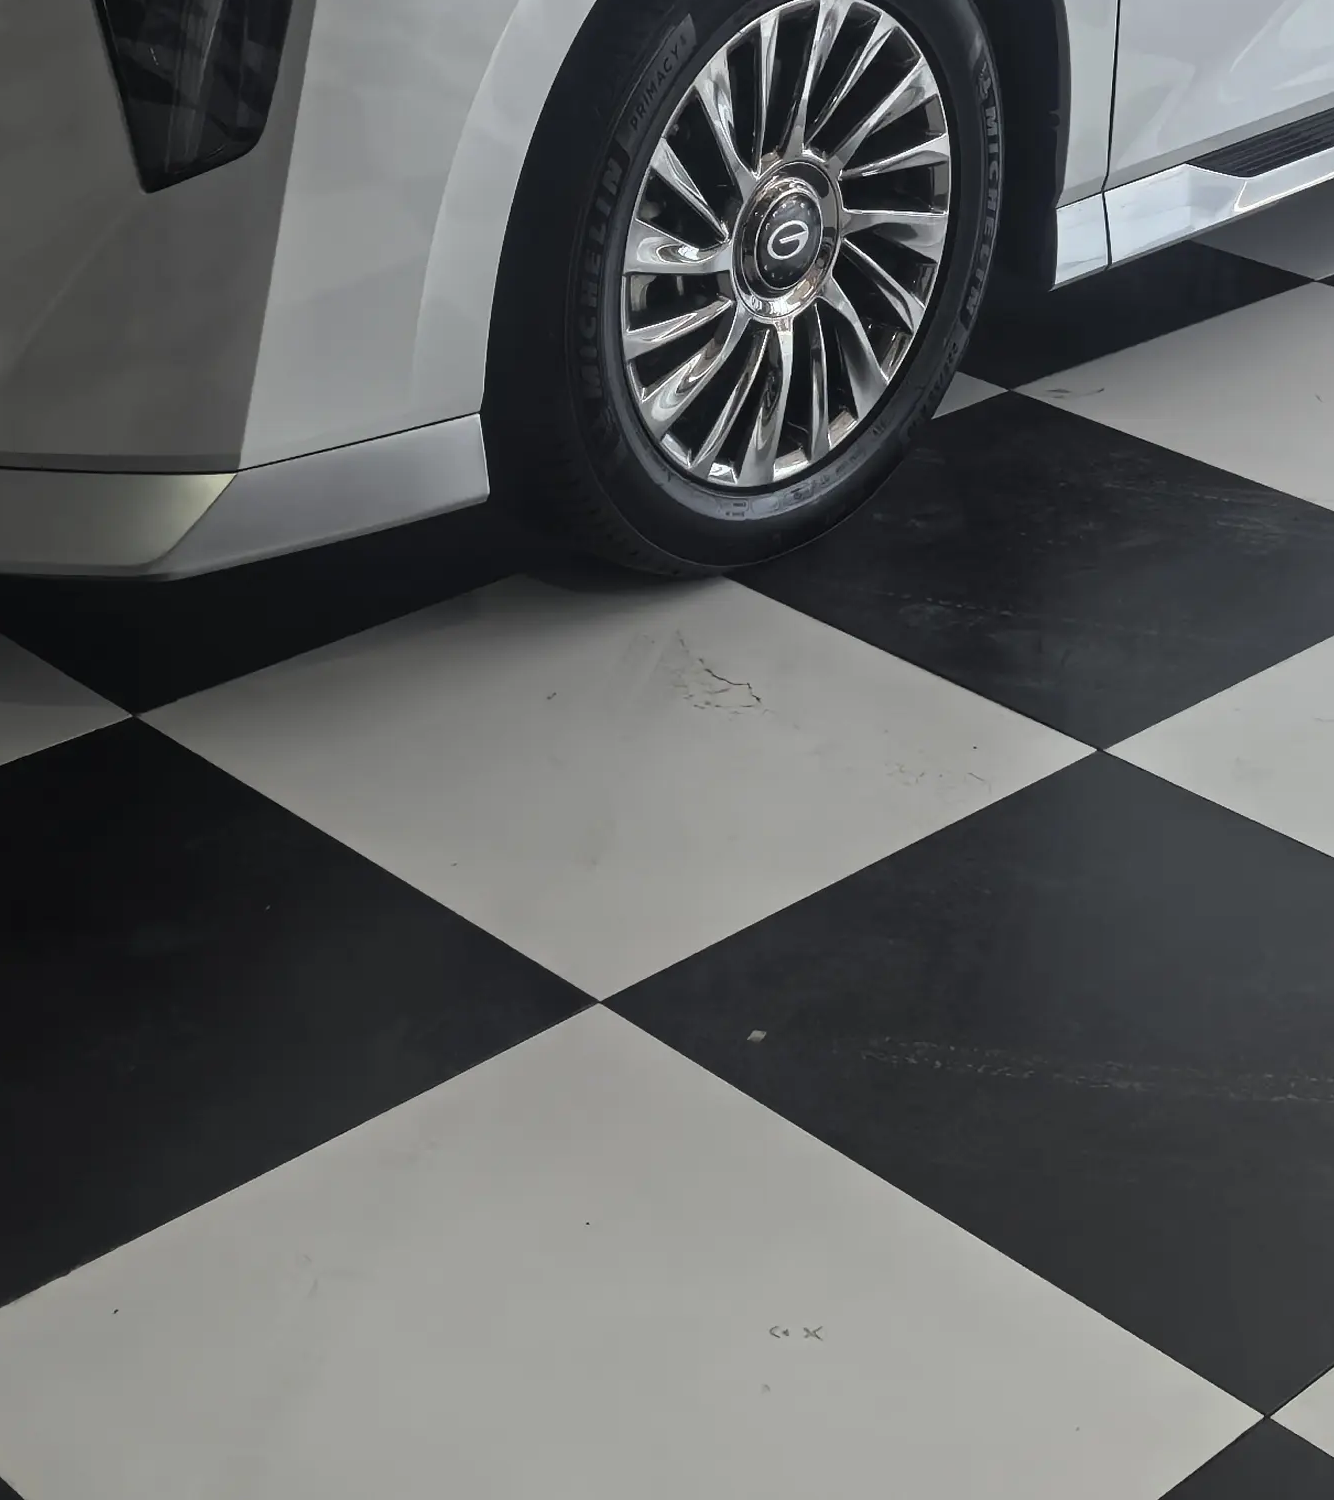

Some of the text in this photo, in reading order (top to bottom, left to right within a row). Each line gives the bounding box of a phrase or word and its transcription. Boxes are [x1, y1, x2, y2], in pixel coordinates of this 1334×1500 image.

[629, 42, 681, 132] PRIMACY
[579, 157, 623, 399] MICHELIN
[966, 106, 999, 317] MICHELIN
